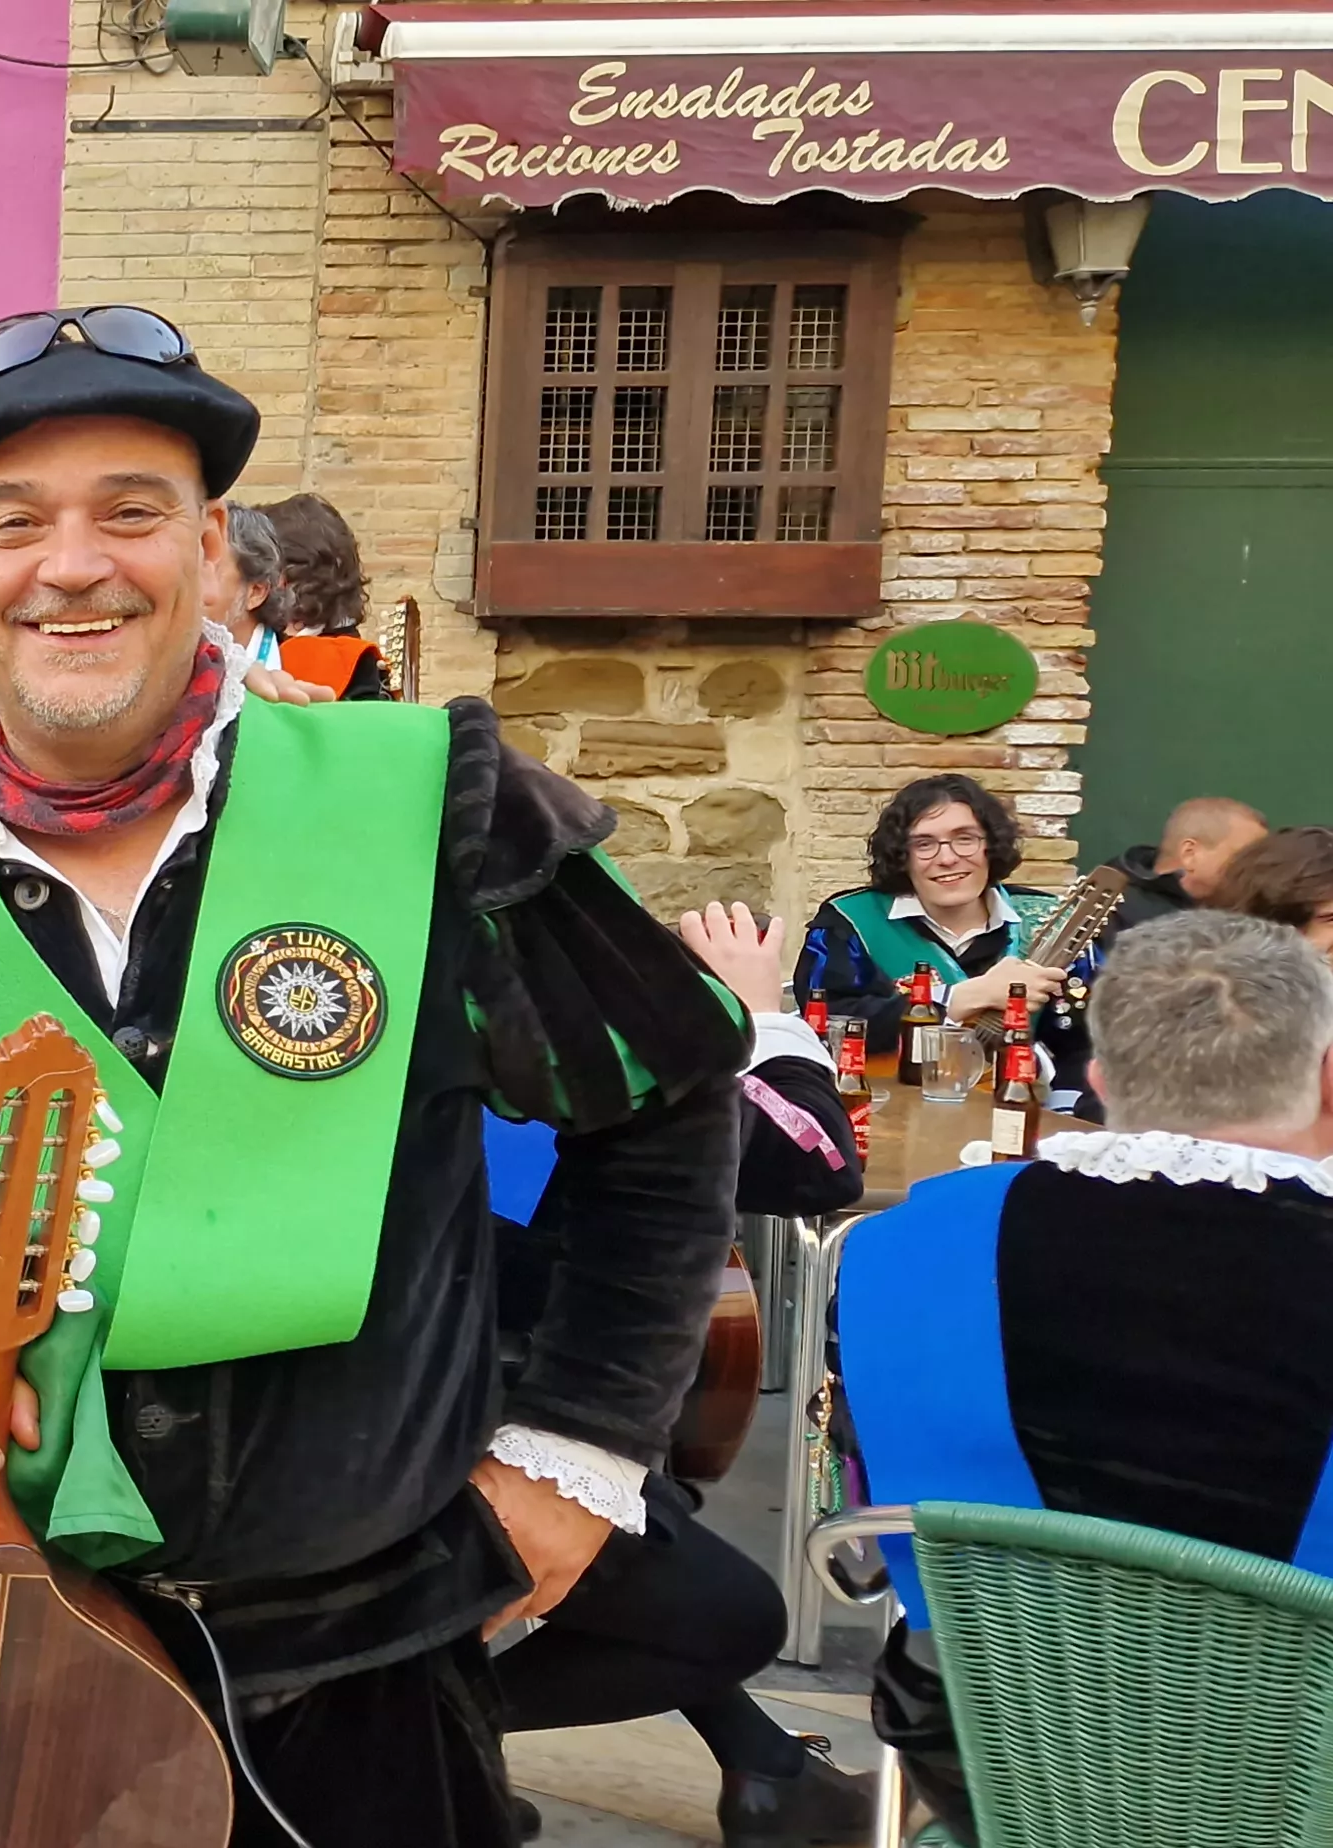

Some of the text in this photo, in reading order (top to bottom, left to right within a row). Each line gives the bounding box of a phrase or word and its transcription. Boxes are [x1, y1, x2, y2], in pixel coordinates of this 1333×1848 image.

[569, 60, 874, 126] Ensaladas
[437, 117, 1010, 182] Raciones Tostadas
[281, 931, 347, 957] TUNA
